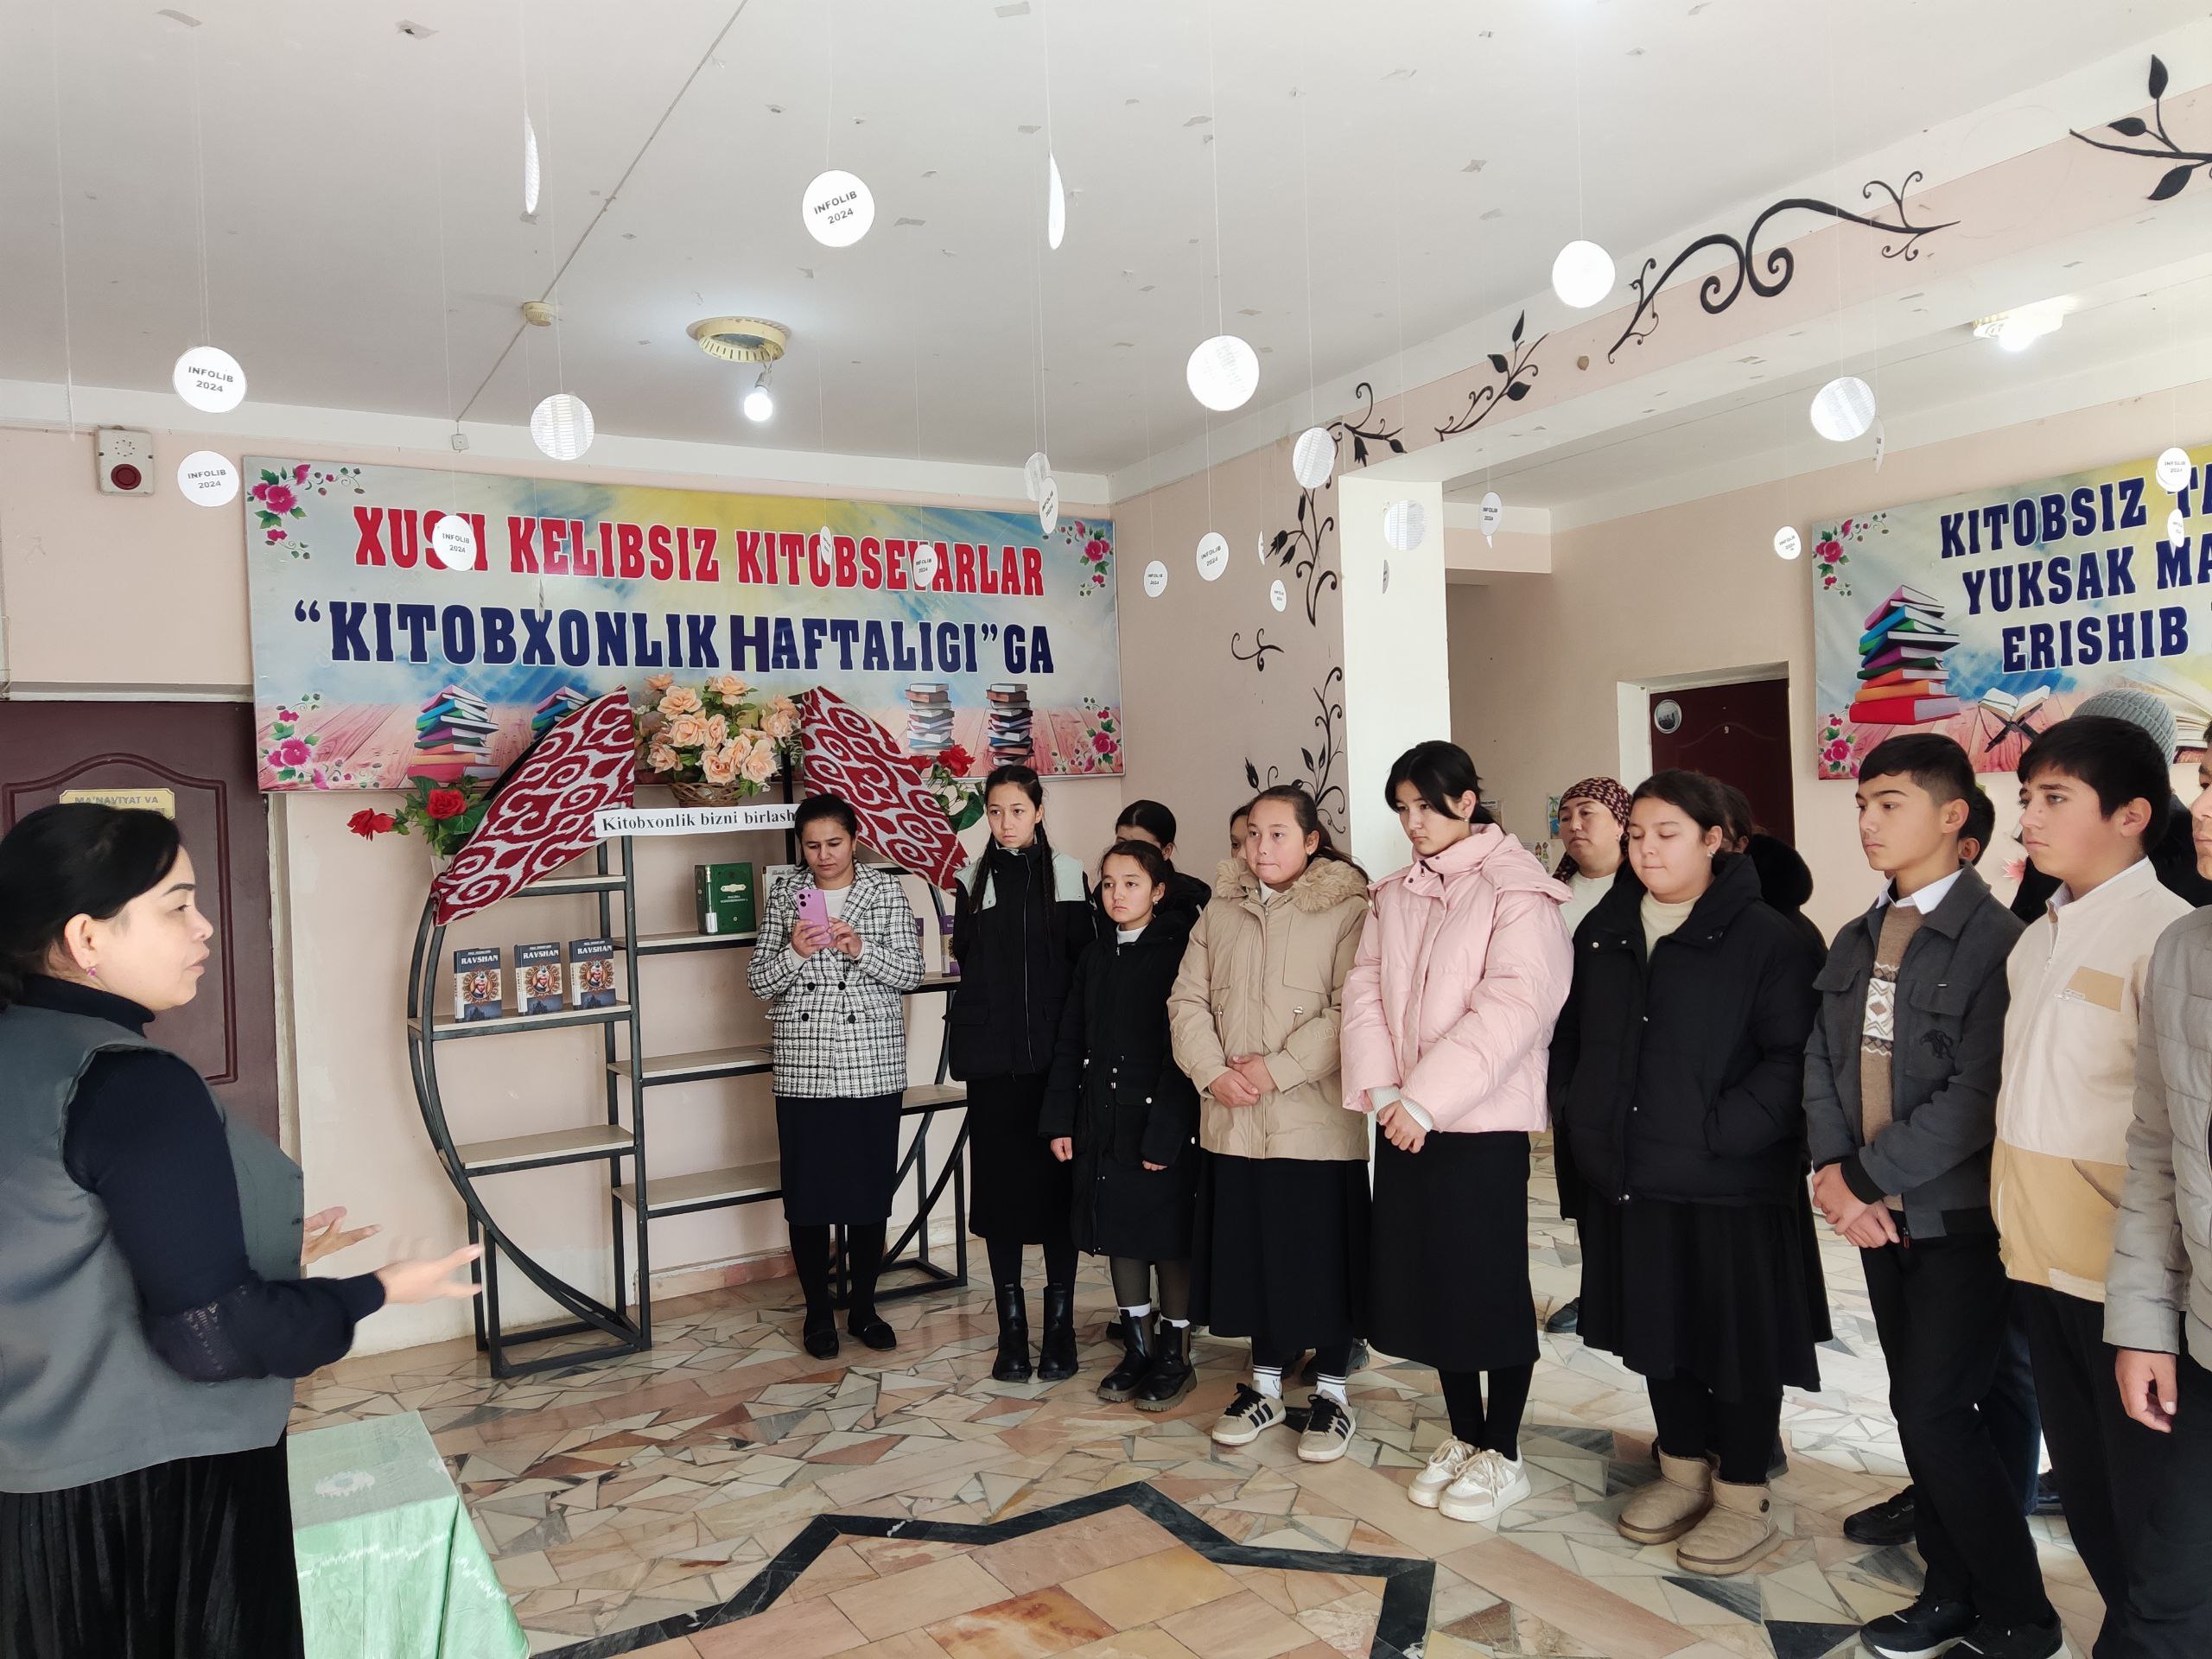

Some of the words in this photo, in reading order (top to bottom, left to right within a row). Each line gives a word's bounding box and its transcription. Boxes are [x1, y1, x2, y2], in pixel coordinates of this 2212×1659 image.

[814, 190, 858, 215] INFOLIB
[827, 207, 854, 225] 2024
[188, 365, 234, 384] INFOLIB
[195, 379, 224, 393] 2024
[188, 468, 227, 480] INFOLIB
[198, 480, 222, 490] 2024
[1940, 477, 2147, 559] KITOBSIZ
[442, 532, 470, 544] INFOLIB
[448, 544, 467, 554] 2024
[507, 515, 720, 583] KELIBSIZ
[1961, 545, 2137, 615] YUKSAK
[2002, 606, 2189, 673] ERISHIB
[602, 813, 696, 831] Kitobxonlik
[700, 810, 738, 826] bizni
[523, 950, 559, 959] RAVSHAN
[577, 944, 613, 955] RAVSHAN
[461, 955, 499, 965] RAVSHAN
